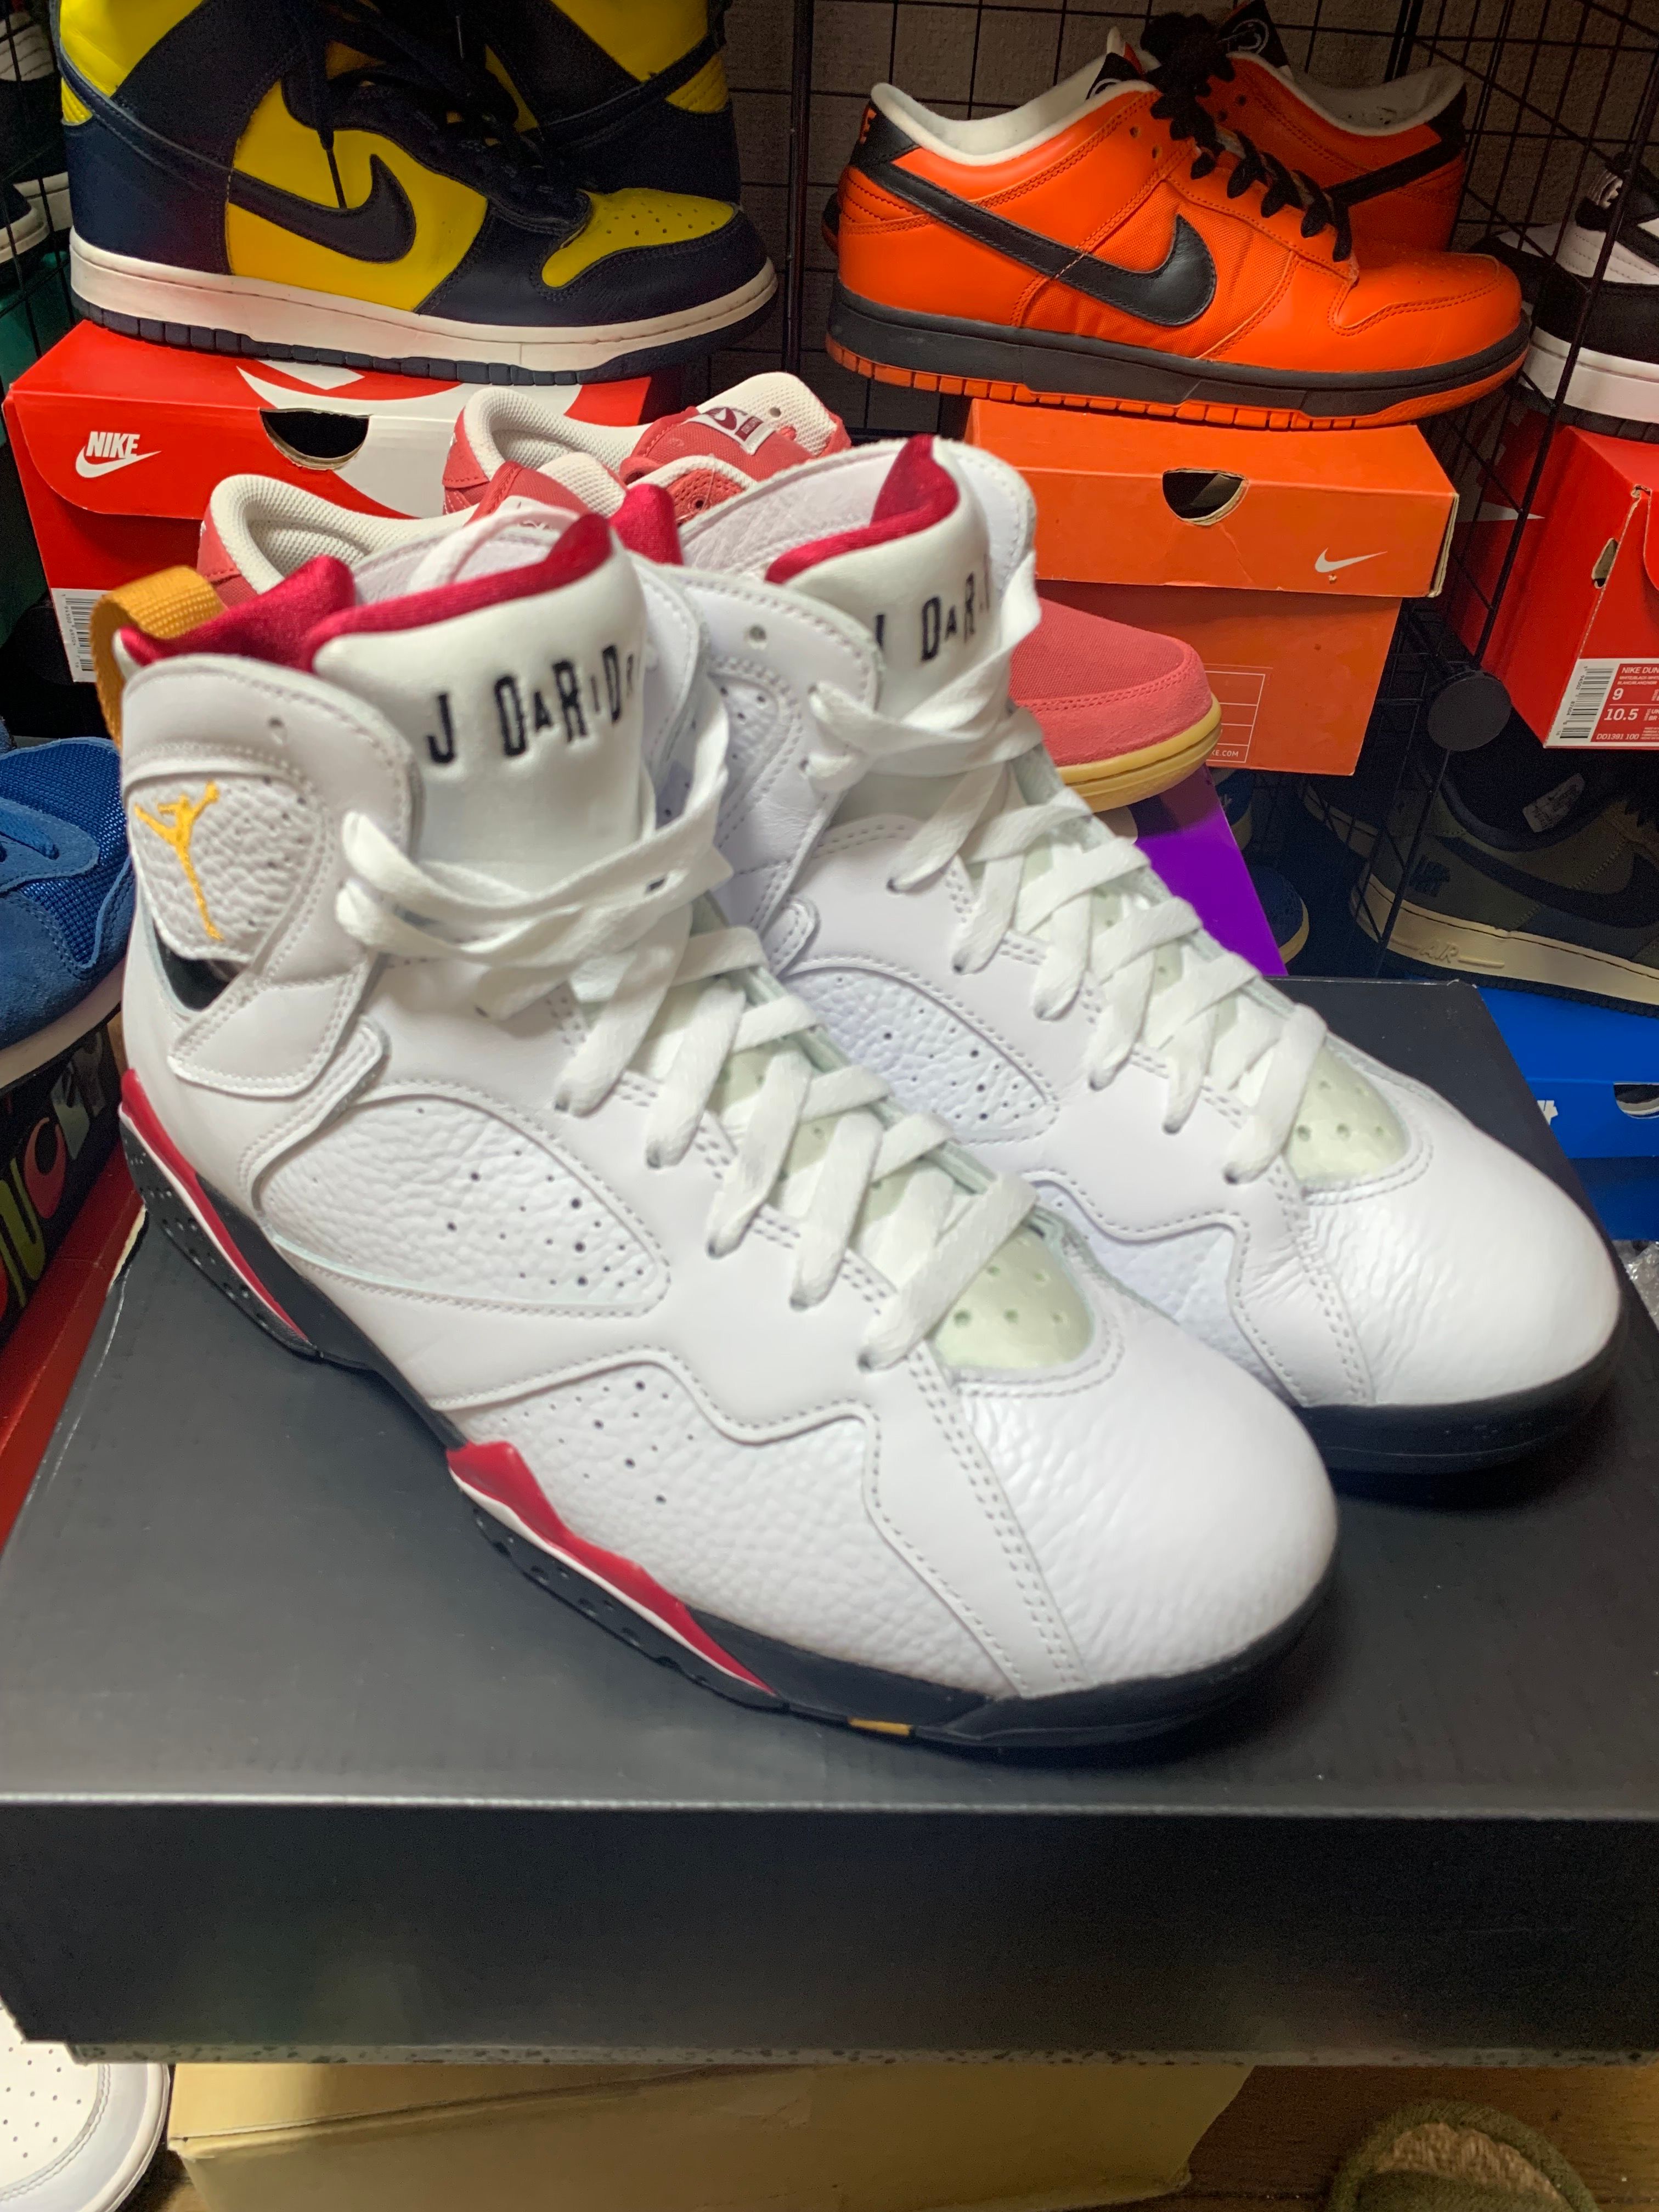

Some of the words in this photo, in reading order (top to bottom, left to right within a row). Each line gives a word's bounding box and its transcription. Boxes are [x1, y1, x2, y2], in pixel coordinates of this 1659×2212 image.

[86, 431, 140, 458] NIKE
[1612, 688, 1624, 701] 9
[1604, 708, 1639, 721] 10.5
